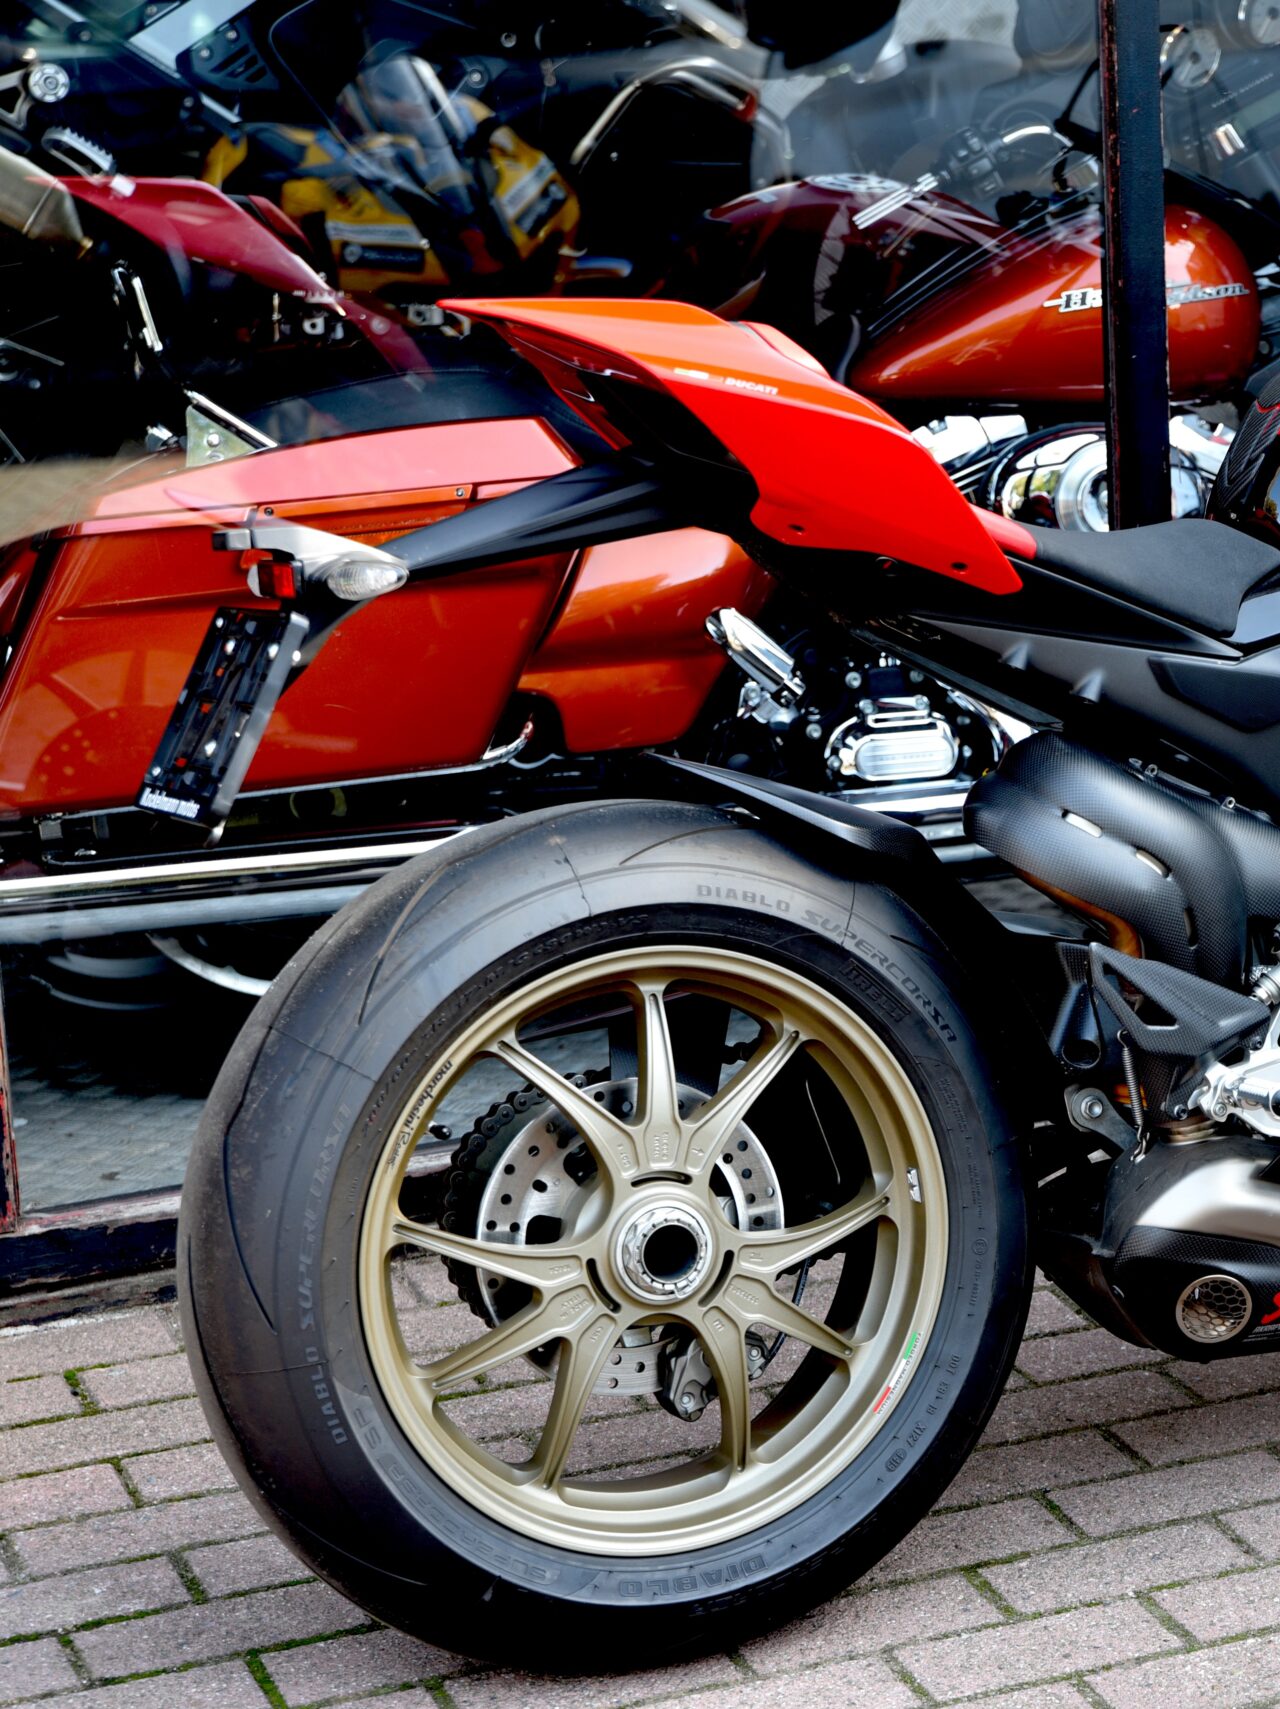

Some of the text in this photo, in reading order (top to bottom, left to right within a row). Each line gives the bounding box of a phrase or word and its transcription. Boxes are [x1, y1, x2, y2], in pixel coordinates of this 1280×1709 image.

[723, 376, 779, 396] DUCATI
[696, 883, 958, 1044] DIABLO SUPERCORSA
[403, 1061, 453, 1132] marchesini
[304, 1345, 349, 1446] DIABLO
[353, 1407, 548, 1578] SUPERCORSA SP
[618, 1553, 768, 1598] DIABLO
